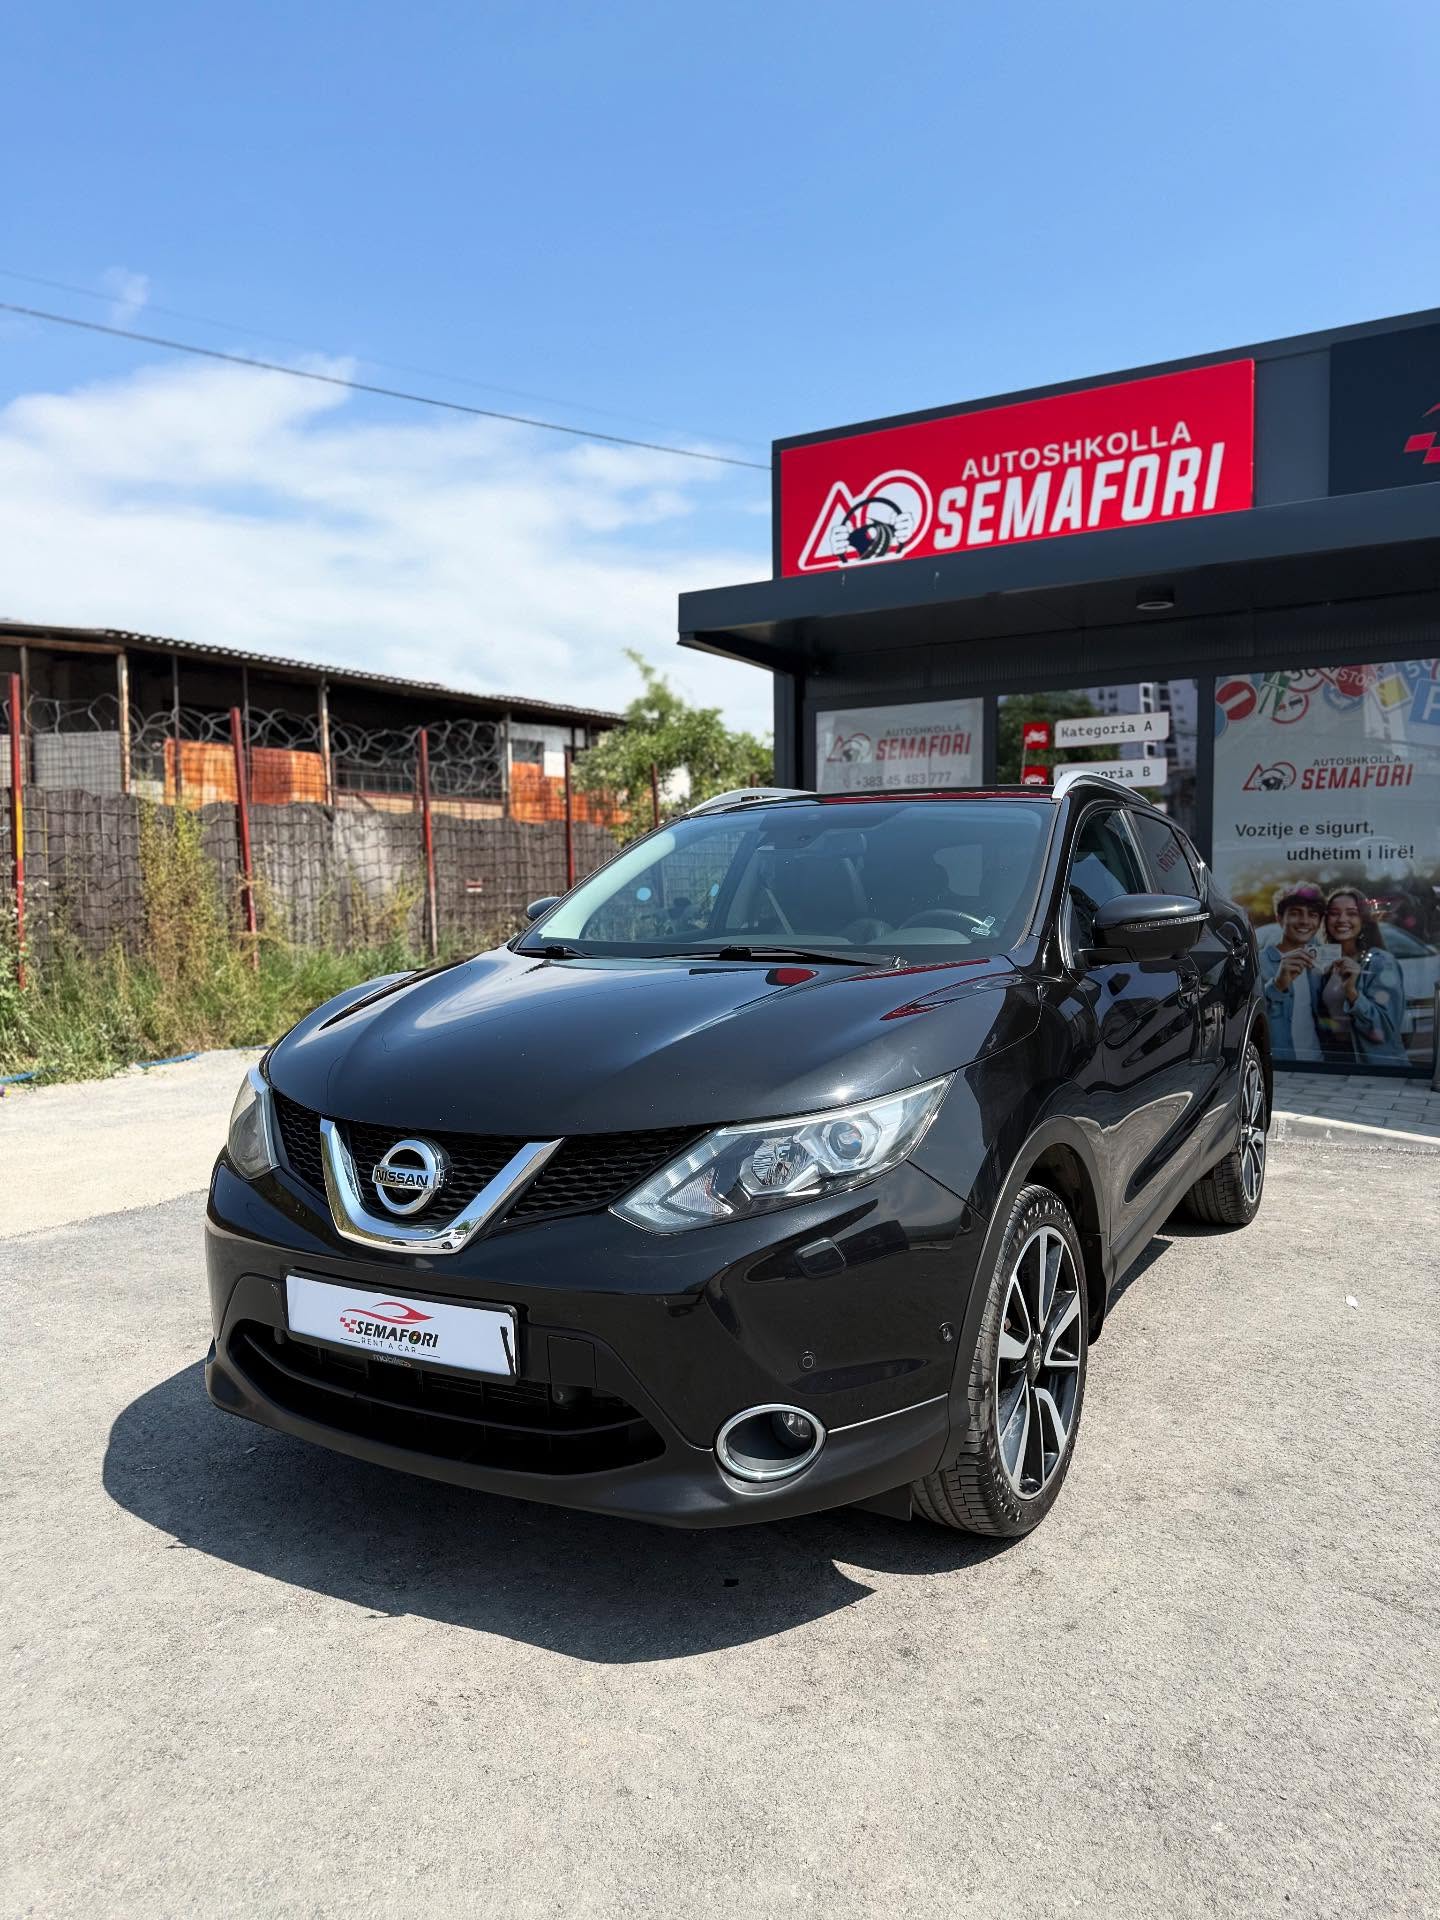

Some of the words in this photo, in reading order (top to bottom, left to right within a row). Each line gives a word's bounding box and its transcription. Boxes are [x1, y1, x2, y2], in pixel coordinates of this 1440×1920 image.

[961, 420, 1192, 481] AUTOSHKOLLA
[932, 441, 1226, 551] SEMAFORI
[885, 723, 962, 737] AUTOSHKOLLA
[1061, 721, 1136, 739] Kategoria
[1143, 720, 1153, 732] A
[876, 731, 972, 761] SEMAFORI
[1312, 754, 1402, 767] AUTOSHKOLLA
[1142, 766, 1151, 777] B
[1301, 763, 1414, 790] SEMAFORI
[1235, 821, 1294, 840] Vozitje
[1299, 823, 1310, 836] e
[1315, 820, 1374, 839] sigurt,
[1286, 846, 1361, 861] udhëtim
[1367, 845, 1373, 860] i
[1378, 844, 1415, 860] lirë!
[375, 1169, 429, 1186] NISSAN
[355, 1320, 439, 1348] SEMAFORI
[361, 1336, 384, 1348] RENT
[388, 1342, 394, 1350] A
[397, 1344, 417, 1353] CAR
